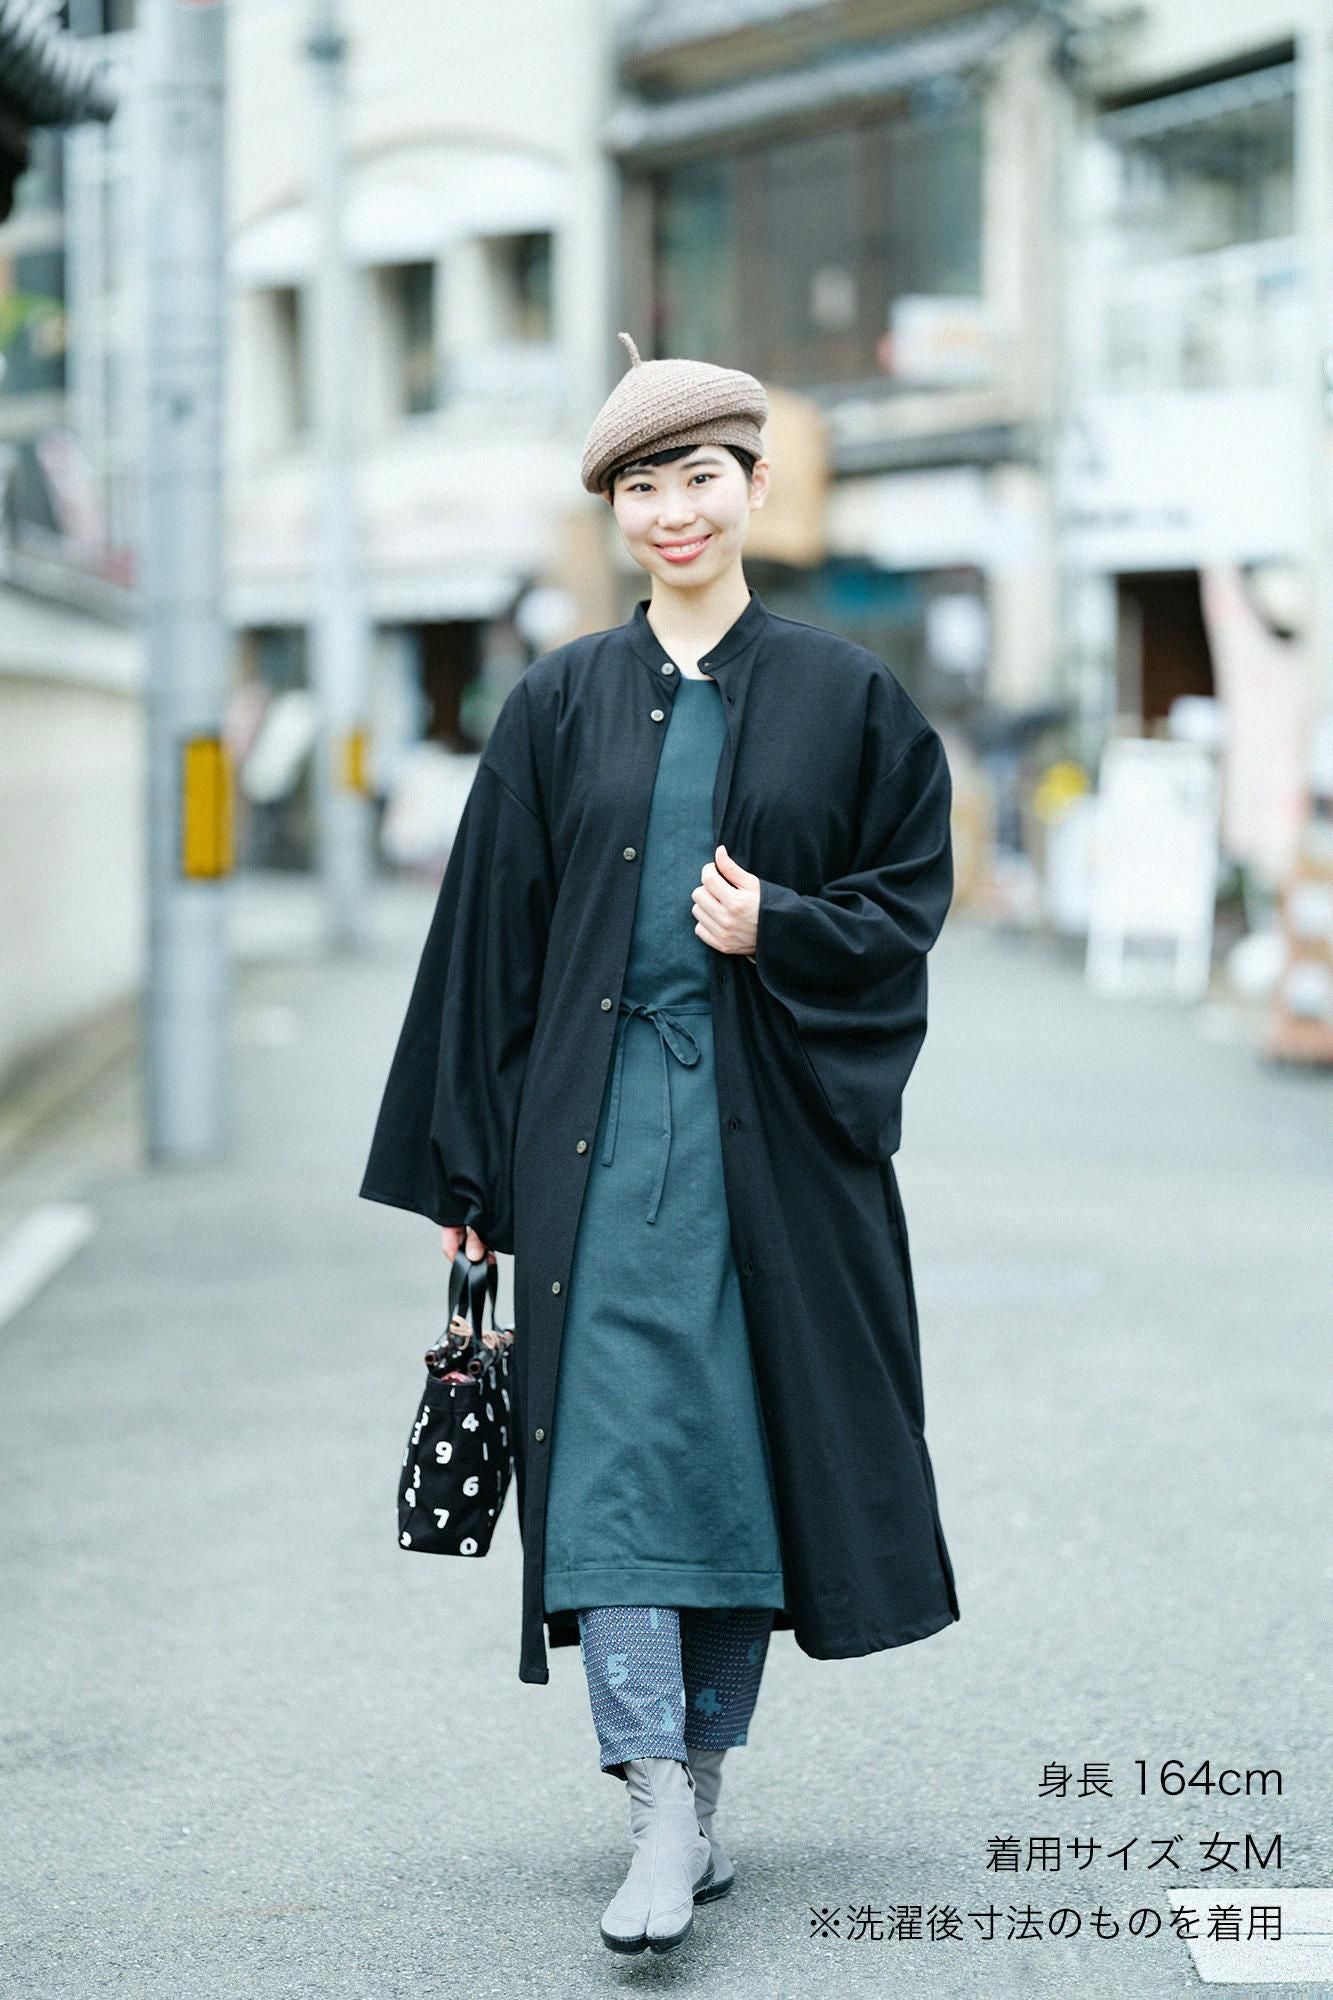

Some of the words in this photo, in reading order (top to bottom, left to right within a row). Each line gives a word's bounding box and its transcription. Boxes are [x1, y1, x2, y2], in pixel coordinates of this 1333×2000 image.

[462, 1413, 479, 1432] 4
[435, 1441, 453, 1464] 9
[462, 1476, 479, 1497] 6
[433, 1508, 450, 1529] 7
[459, 1537, 478, 1555] 0
[607, 1653, 629, 1686] 5
[694, 1688, 722, 1717] 4
